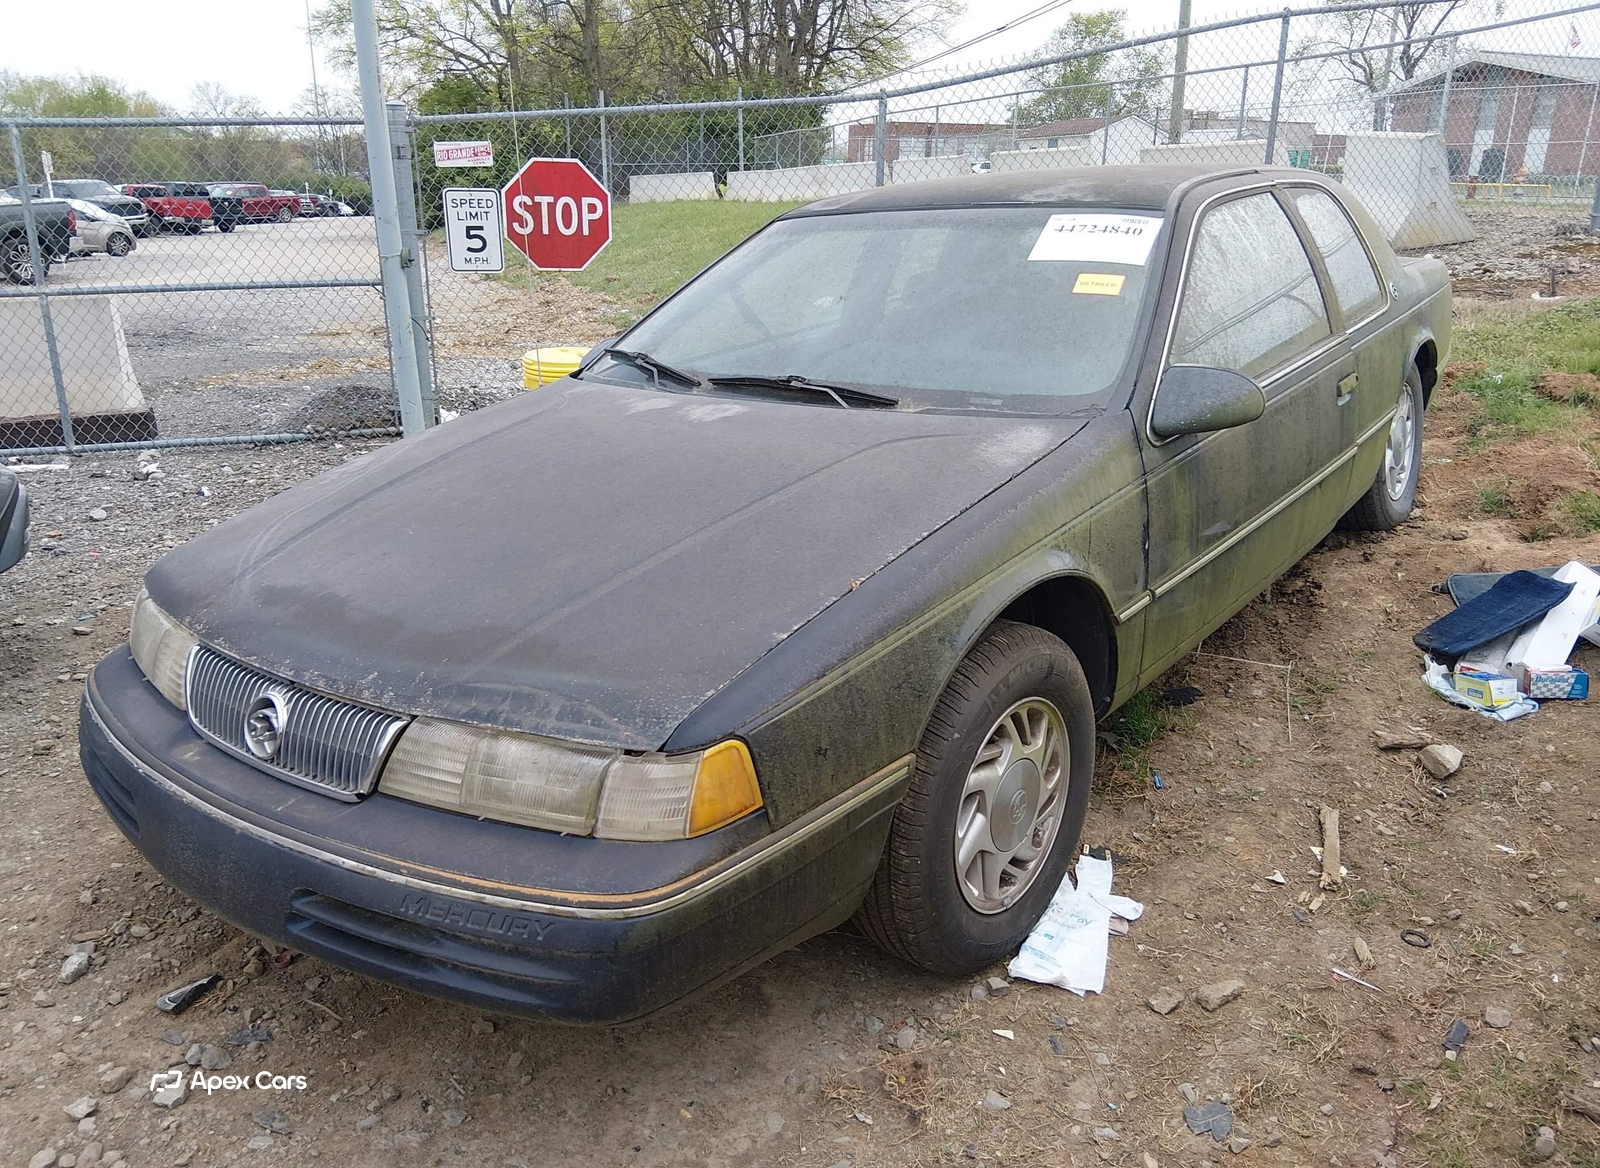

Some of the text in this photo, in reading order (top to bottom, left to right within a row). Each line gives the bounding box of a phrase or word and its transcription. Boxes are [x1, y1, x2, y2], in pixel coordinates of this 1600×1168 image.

[436, 147, 475, 161] RIO GRANDE
[450, 198, 494, 209] SPEED
[456, 211, 491, 222] LIMIT
[512, 195, 603, 236] STOP
[1054, 224, 1143, 236] 44724840
[465, 226, 487, 253] 5
[464, 256, 491, 265] M.P.H.
[1535, 675, 1570, 684] Duralast
[399, 893, 557, 942] MERCURY
